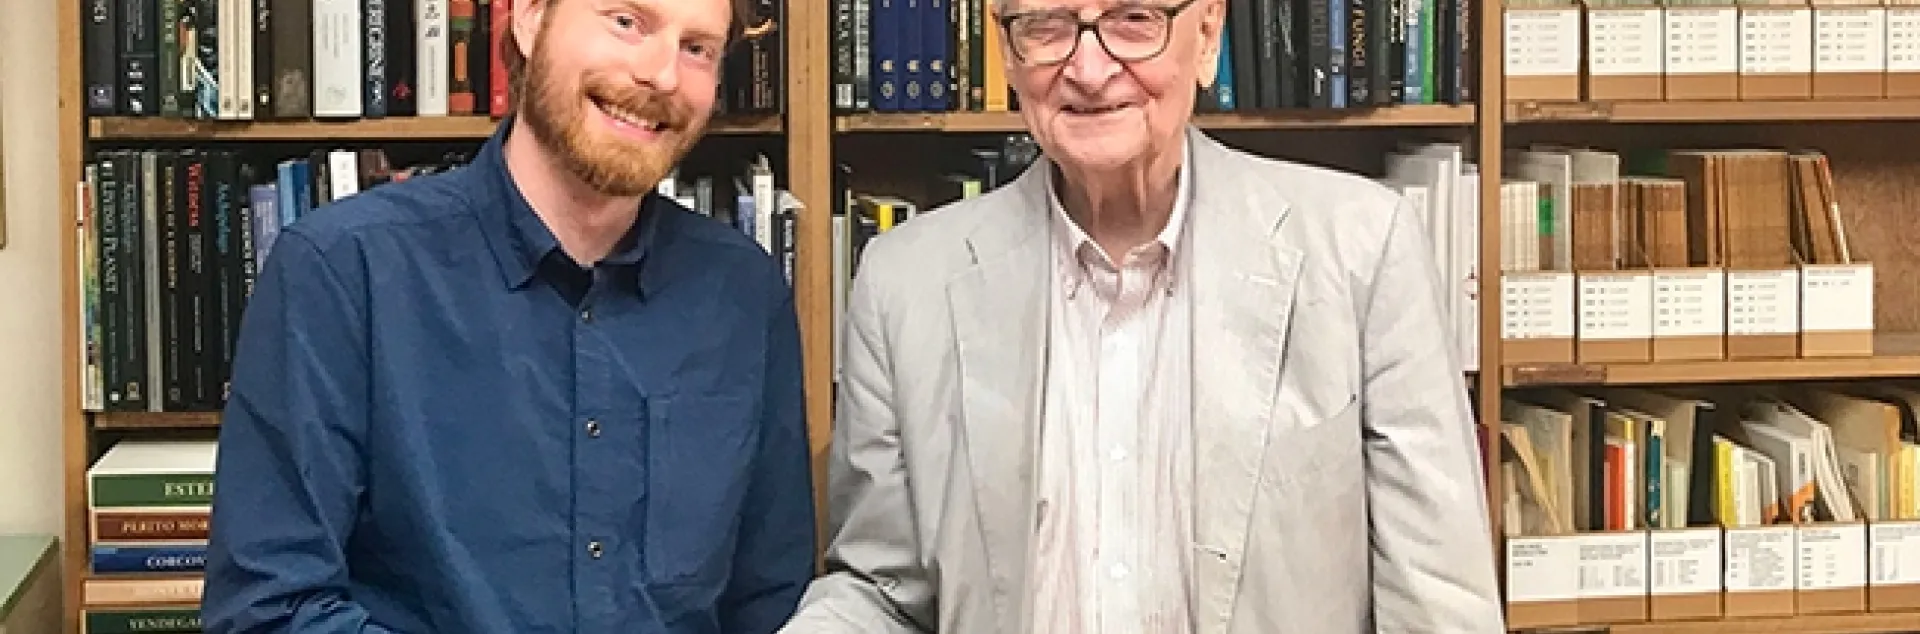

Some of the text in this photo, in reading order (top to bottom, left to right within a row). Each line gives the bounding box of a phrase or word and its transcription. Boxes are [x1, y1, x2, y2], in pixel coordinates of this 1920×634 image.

[1352, 9, 1366, 67] FUNGI
[103, 181, 116, 233] LIVING
[103, 237, 119, 293] PLANET
